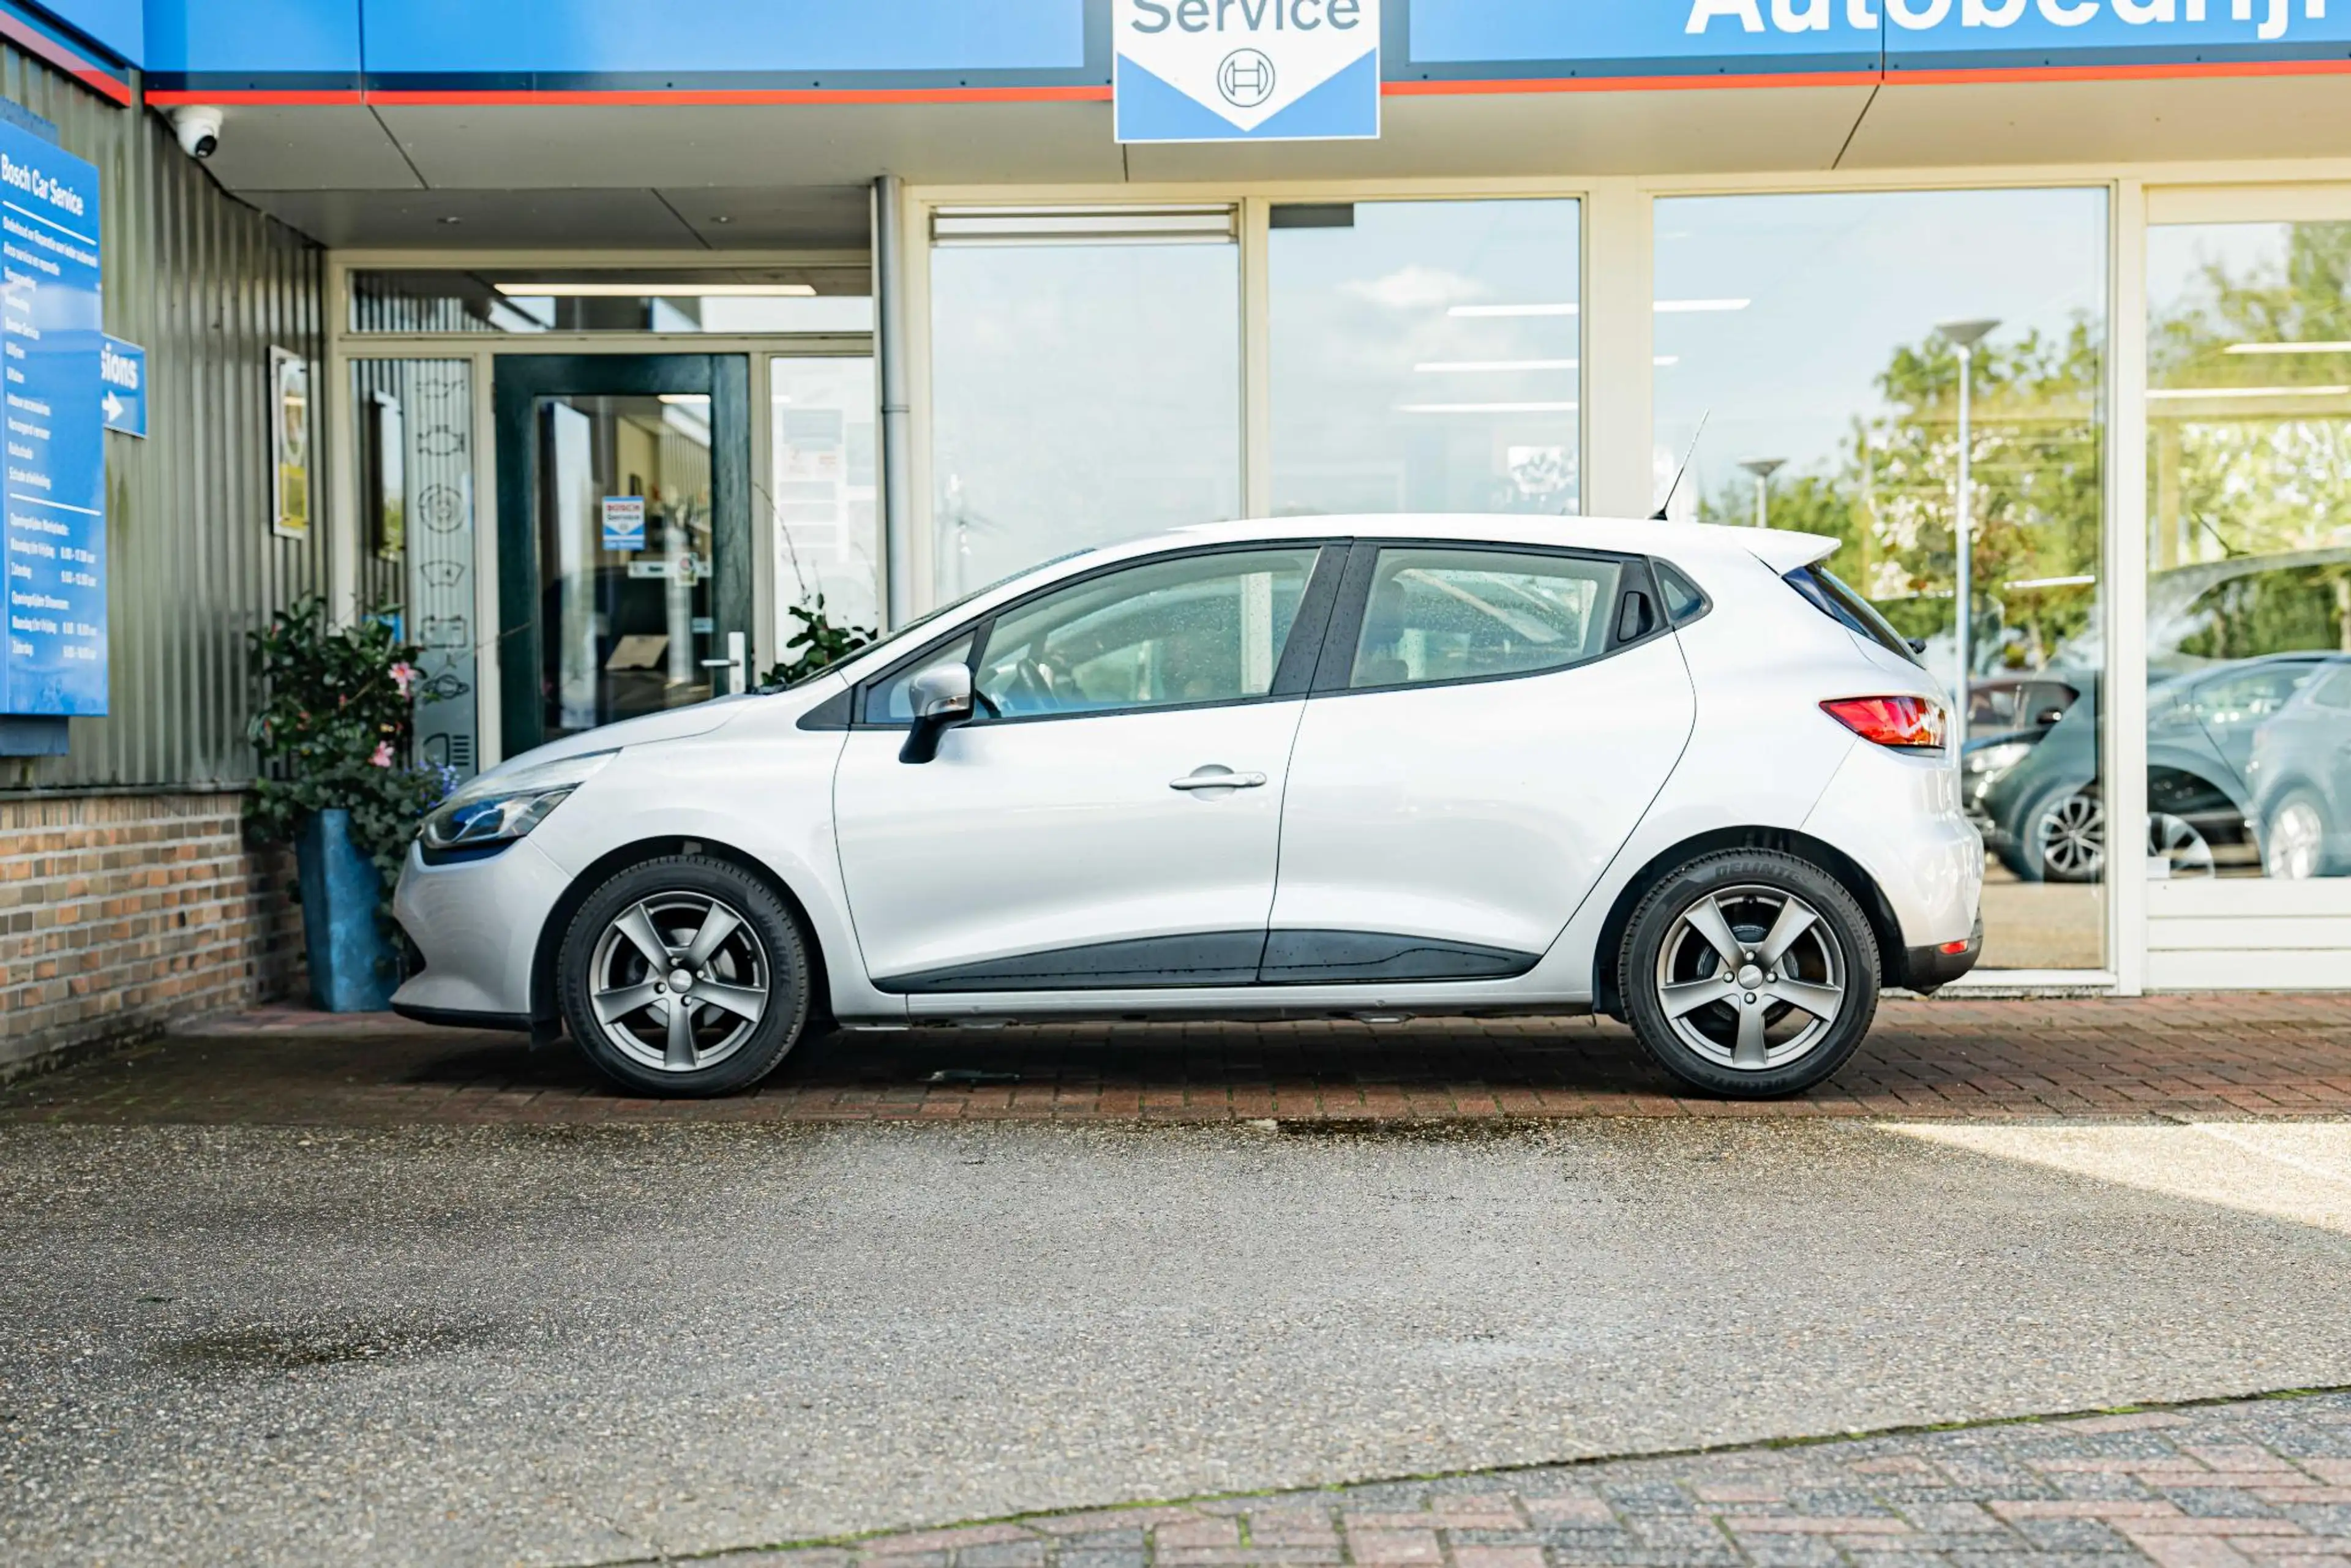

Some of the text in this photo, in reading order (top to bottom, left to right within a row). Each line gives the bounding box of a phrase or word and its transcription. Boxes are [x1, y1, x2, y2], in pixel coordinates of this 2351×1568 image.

[1131, 0, 1360, 33] Service
[2, 153, 83, 218] Bosch Car Service
